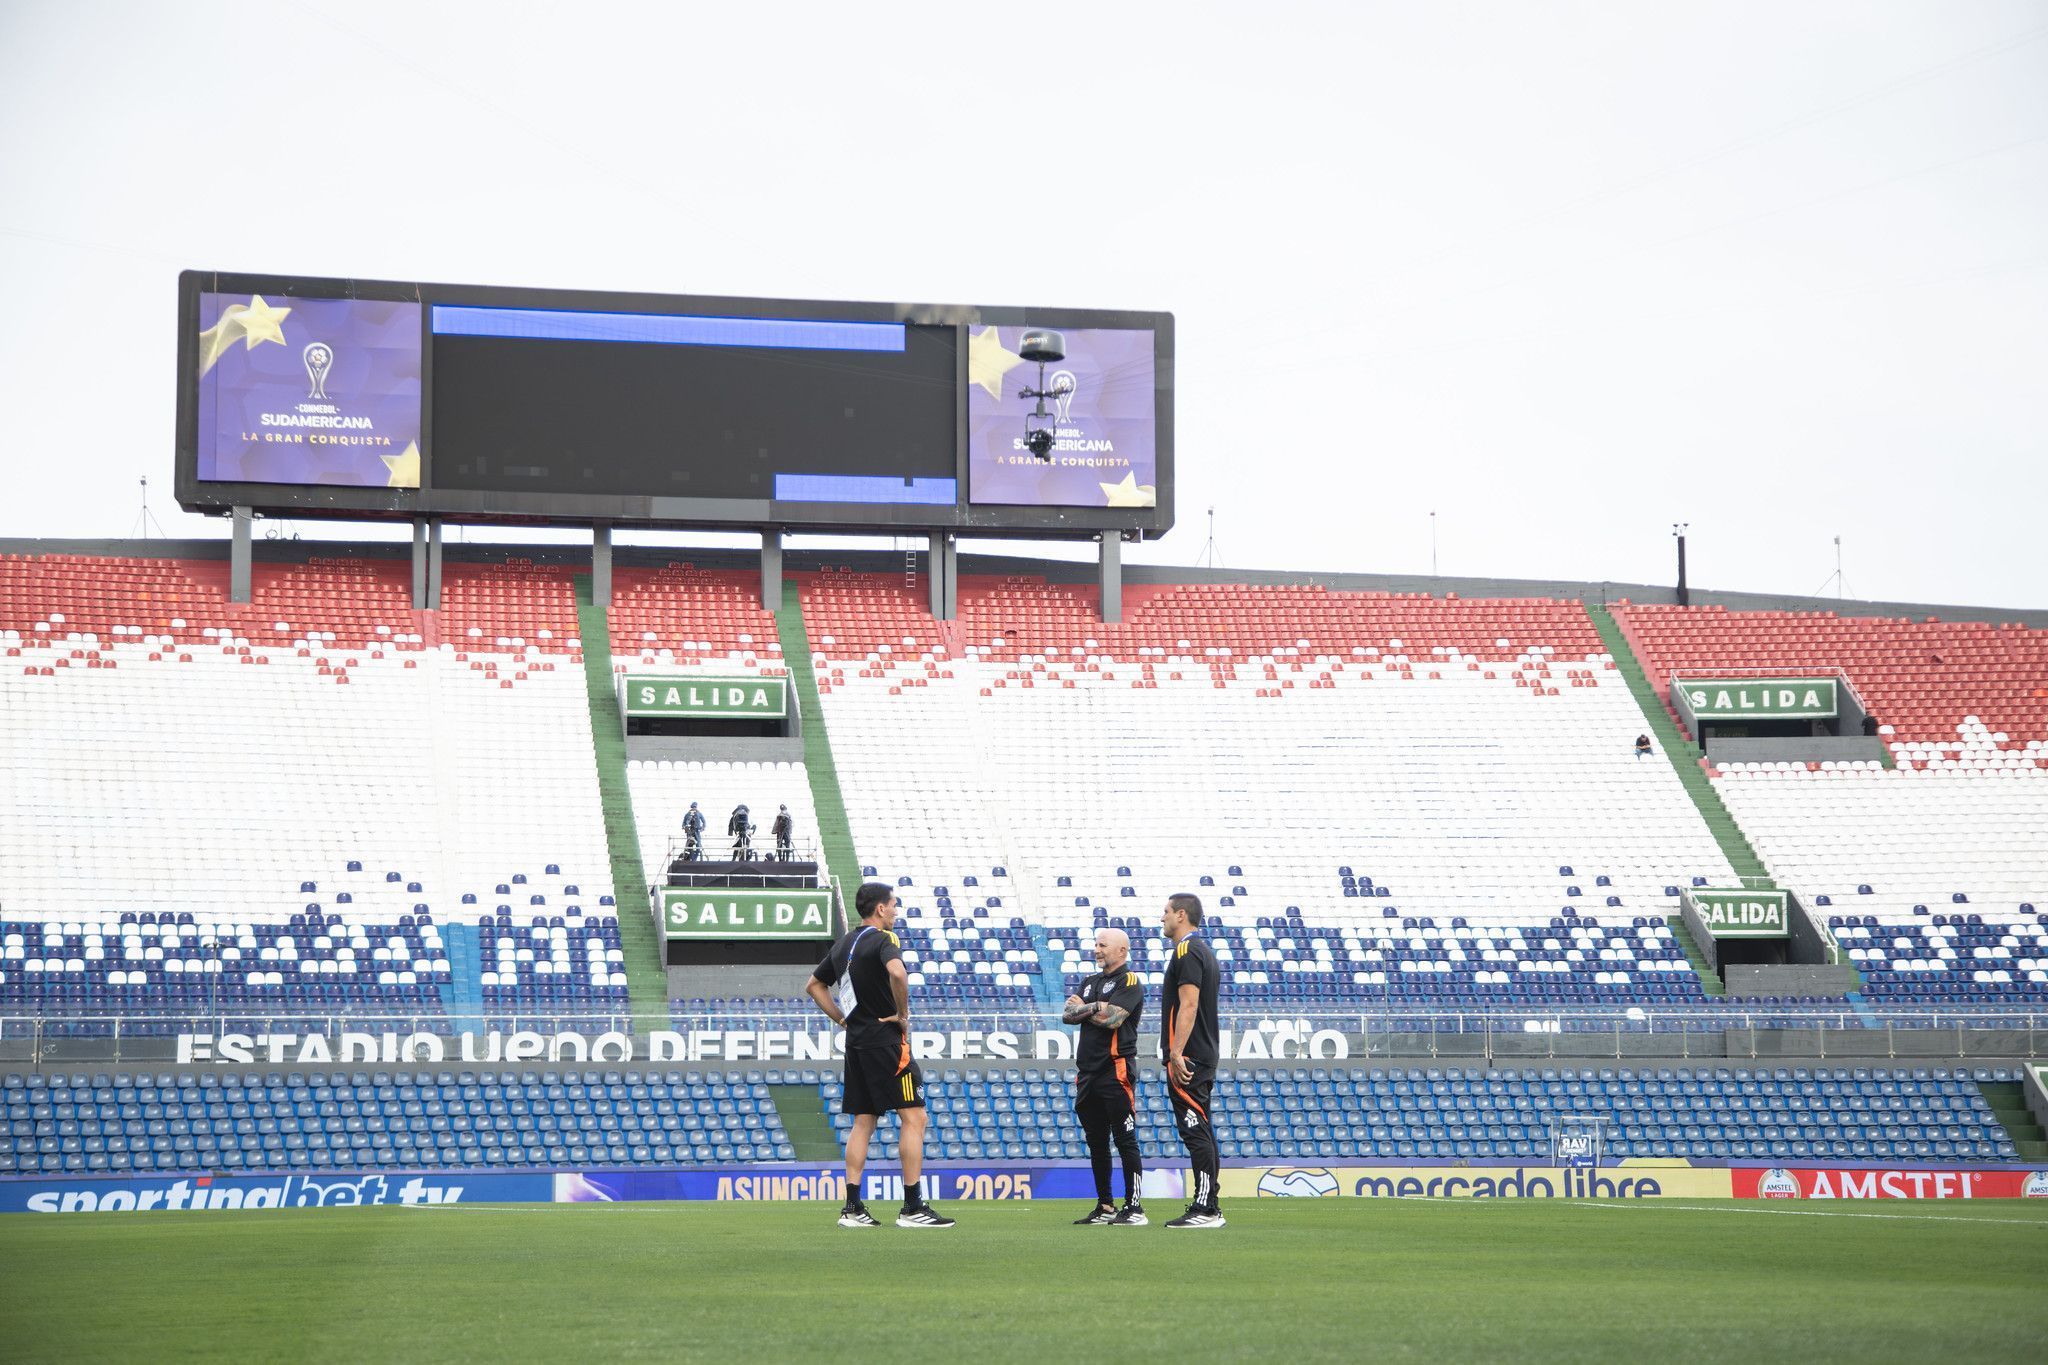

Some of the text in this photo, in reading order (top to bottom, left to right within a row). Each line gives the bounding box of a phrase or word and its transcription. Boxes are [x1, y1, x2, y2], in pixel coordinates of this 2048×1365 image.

[261, 413, 373, 430] SUDAMERICANA
[242, 432, 391, 446] LA GRAN CONQUISTA
[997, 456, 1005, 465] A
[1061, 456, 1130, 468] CONQUISTA
[640, 686, 769, 707] SALIDA
[1691, 689, 1822, 709] SALIDA
[670, 902, 824, 926] SALIDA
[1699, 902, 1780, 925] SALIDA
[176, 1032, 444, 1064] ESTADIO
[955, 1174, 1032, 1200] 2025
[1355, 1168, 1662, 1198] mercado libre
[1766, 1184, 1792, 1192] AMSTEL
